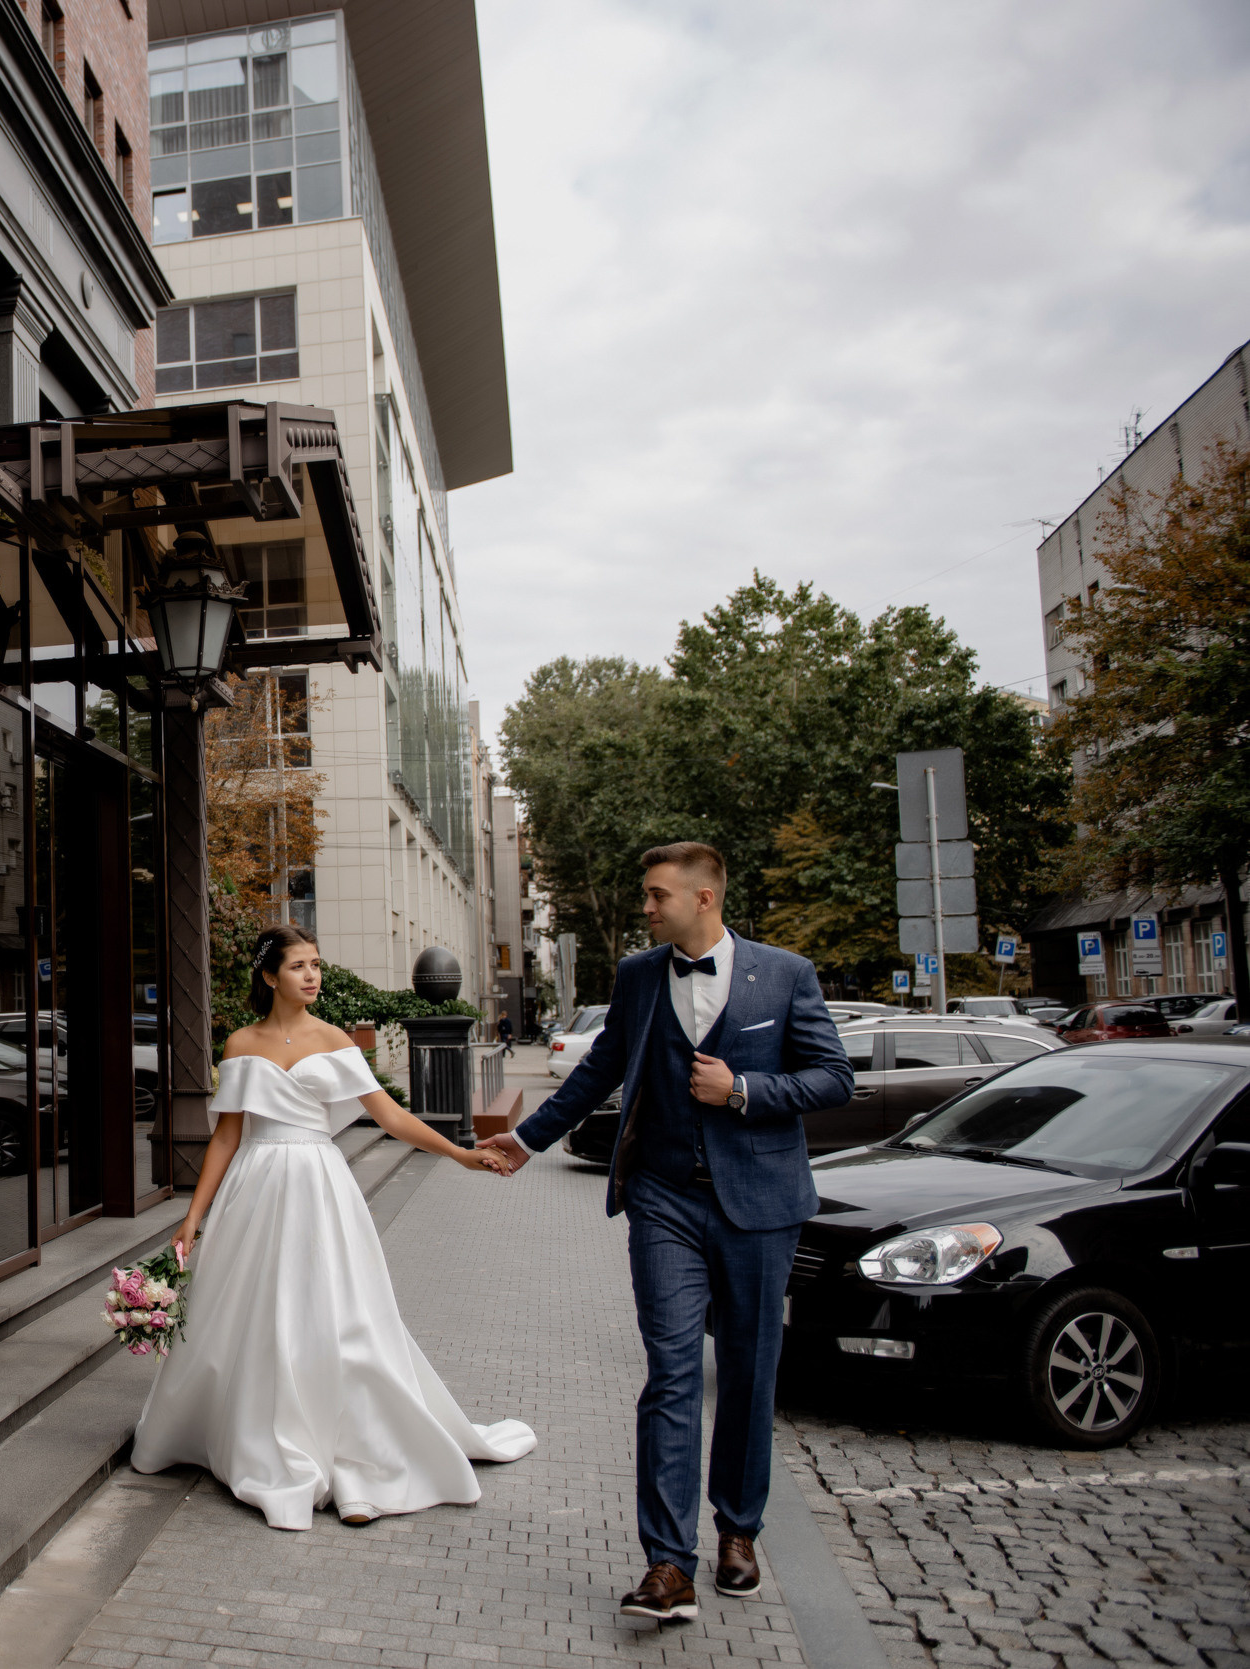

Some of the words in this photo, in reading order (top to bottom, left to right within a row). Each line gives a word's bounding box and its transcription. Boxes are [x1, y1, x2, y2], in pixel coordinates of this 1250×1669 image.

[1138, 922, 1150, 938] P
[1001, 942, 1011, 954] P
[1084, 940, 1095, 954] P
[1215, 935, 1223, 955] P
[928, 957, 938, 973] P
